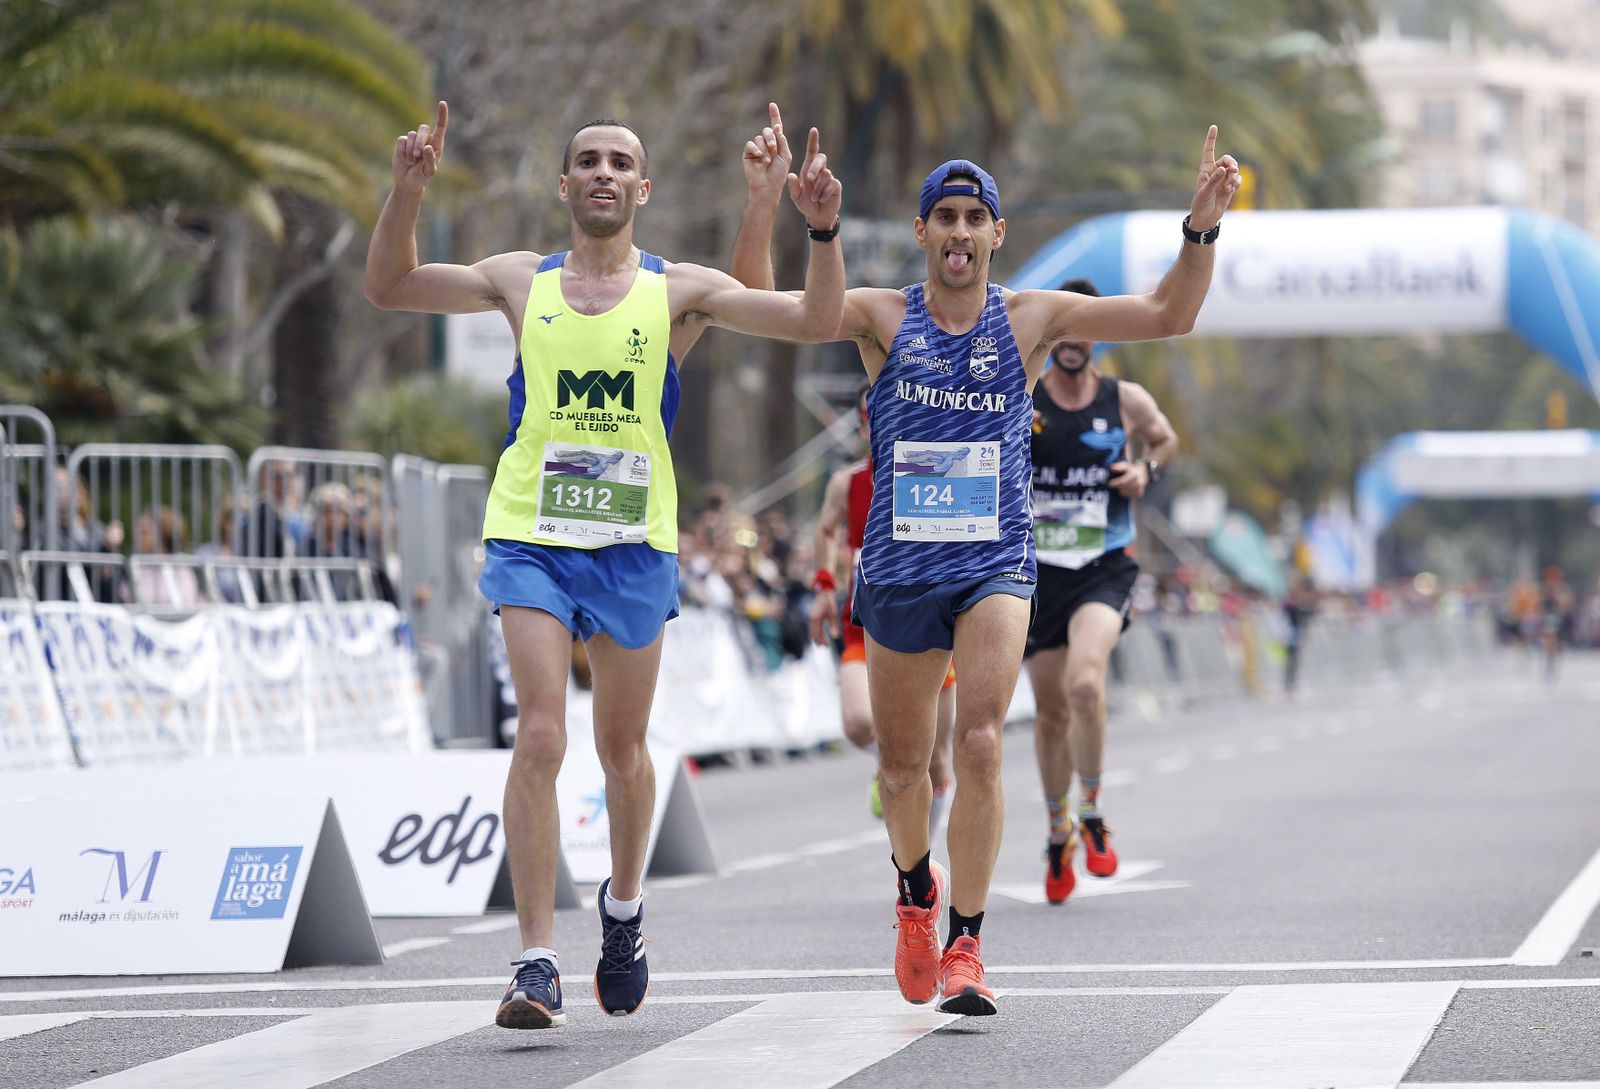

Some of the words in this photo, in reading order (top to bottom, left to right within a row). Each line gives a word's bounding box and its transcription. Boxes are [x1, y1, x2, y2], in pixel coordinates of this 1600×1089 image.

[899, 353, 953, 373] CONTINENTAL
[895, 380, 1007, 413] ALMUÑÉCAR
[549, 411, 563, 420] CD
[567, 412, 613, 422] MUEBLES
[616, 414, 641, 425] MESA
[575, 422, 586, 431] EL
[589, 423, 619, 432] EJIDO
[980, 447, 995, 459] 24
[633, 455, 647, 468] 24
[551, 483, 613, 510] 1312
[910, 484, 955, 506] 124
[538, 522, 556, 533] edp
[896, 523, 911, 534] edp
[378, 795, 500, 884] edp
[223, 875, 283, 908] laga
[1, 899, 34, 909] SPORT
[123, 909, 179, 924] diputación
